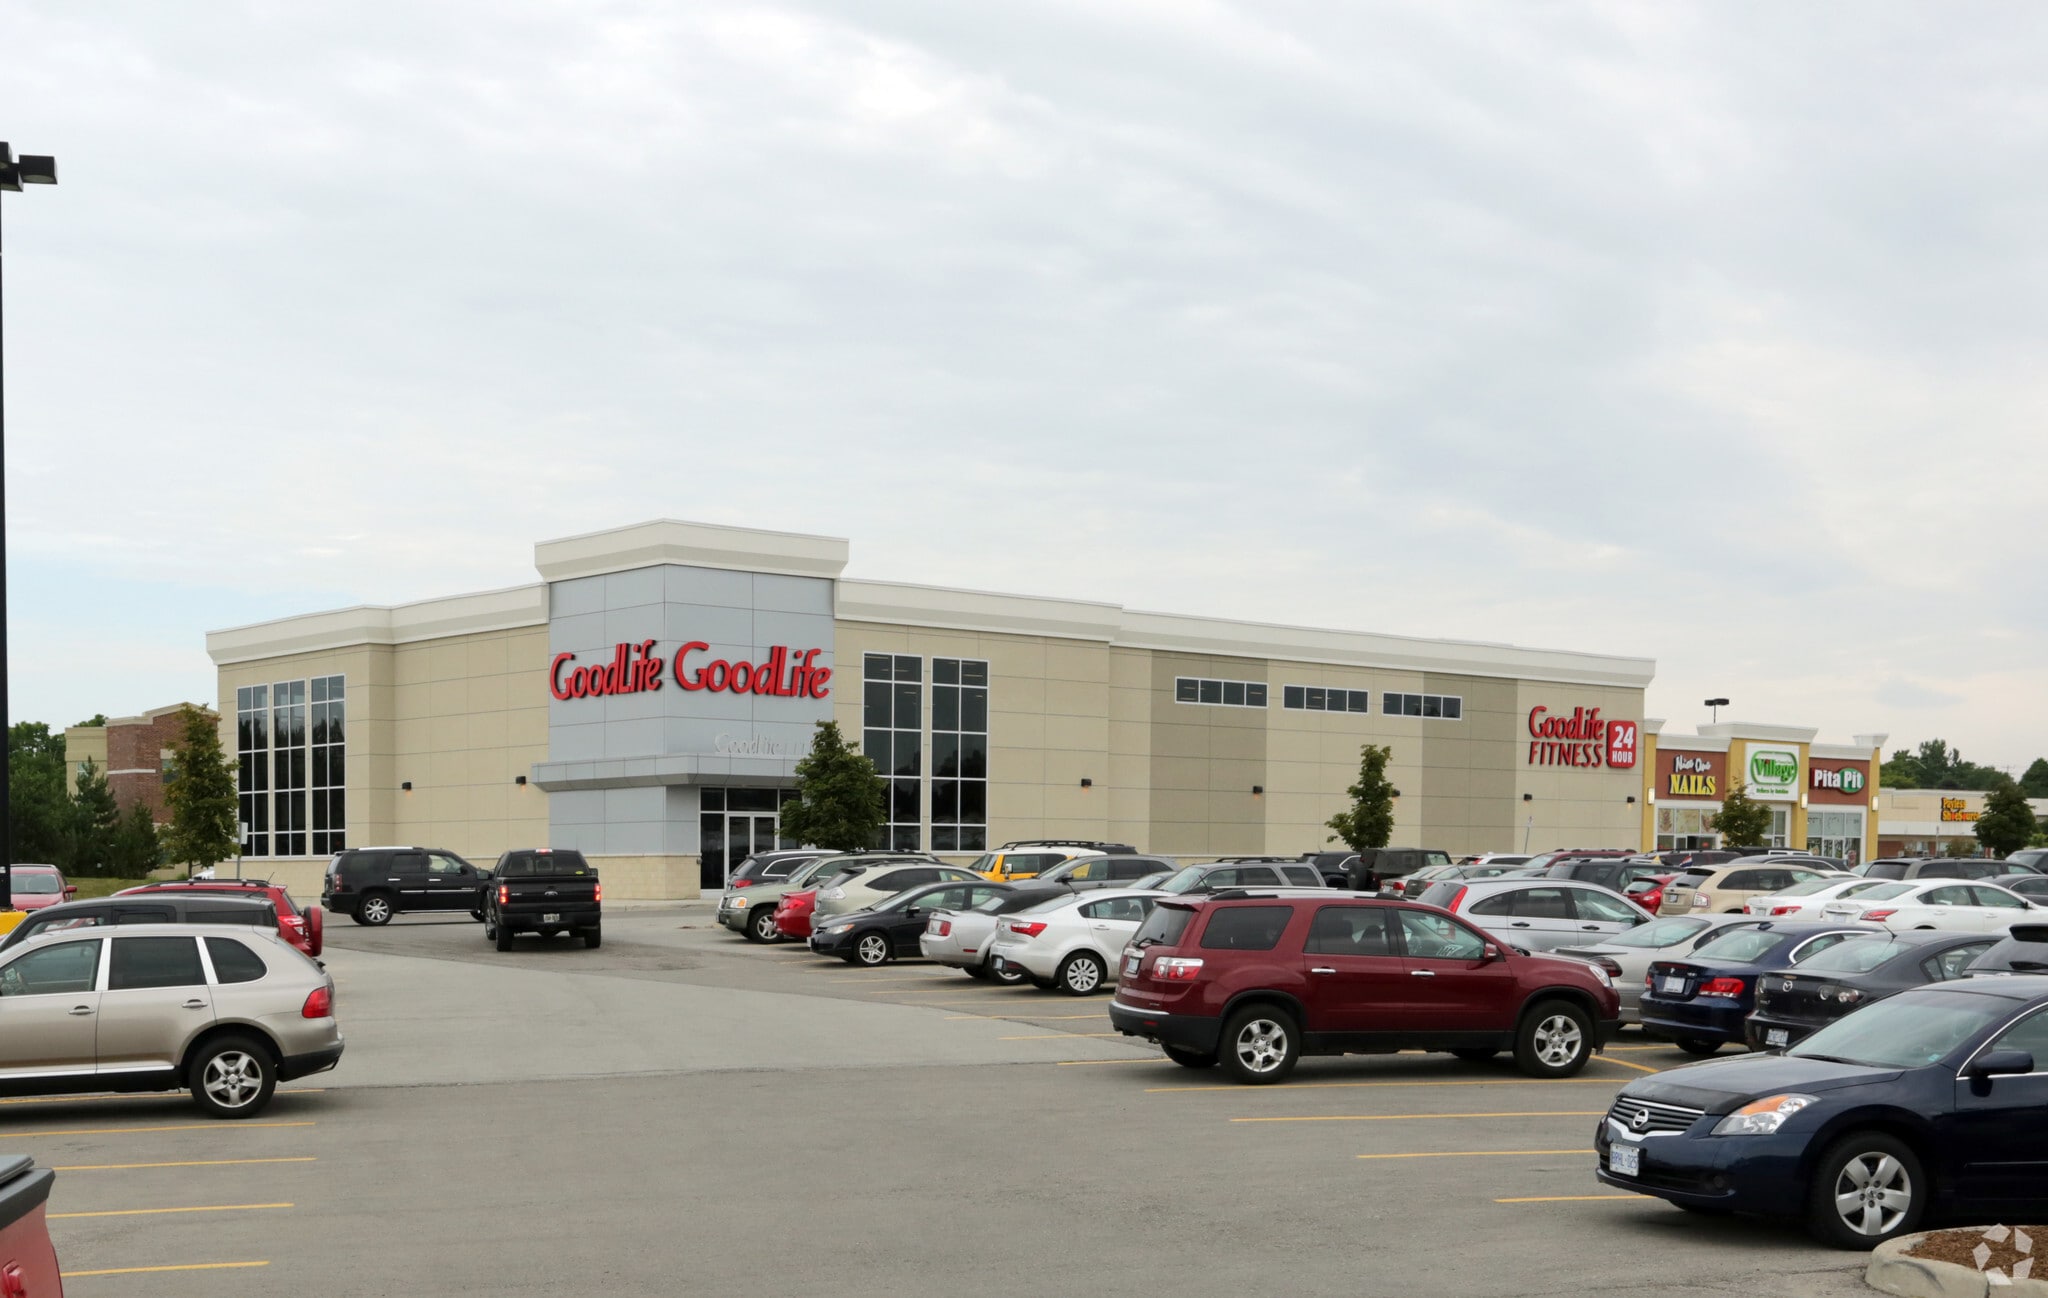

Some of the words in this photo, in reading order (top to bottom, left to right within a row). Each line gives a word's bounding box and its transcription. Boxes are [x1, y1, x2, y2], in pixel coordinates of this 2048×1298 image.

[550, 639, 664, 700] GoodLife
[674, 641, 831, 699] GoodLife
[1530, 706, 1604, 740] GoodLife
[1613, 725, 1635, 749] 24
[1530, 741, 1603, 767] FITNESS
[1612, 751, 1633, 763] HOUR
[1754, 758, 1796, 782] Village
[1813, 769, 1841, 788] Pita
[1843, 770, 1862, 789] Pit
[1669, 774, 1716, 796] NAILS
